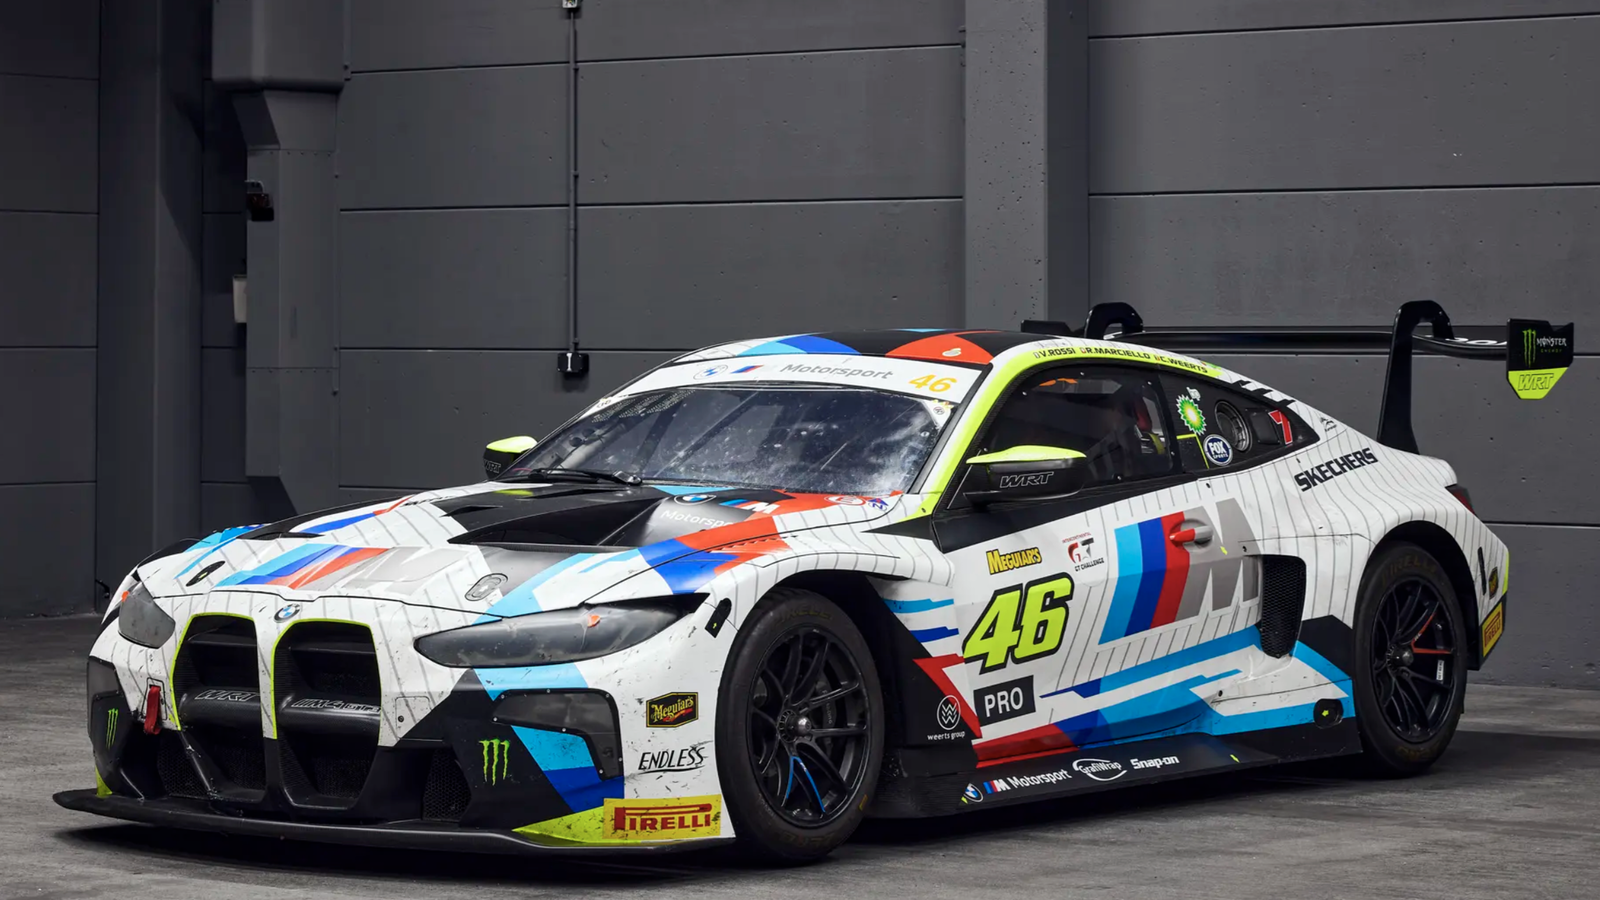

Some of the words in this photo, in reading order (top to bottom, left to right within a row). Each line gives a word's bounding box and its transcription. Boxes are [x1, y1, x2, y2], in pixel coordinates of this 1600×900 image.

[1536, 335, 1567, 347] MONSTER
[1040, 347, 1076, 358] V.ROSSI
[1086, 347, 1151, 359] R.MARCIELLO
[1160, 355, 1208, 374] C.WEERTS
[779, 364, 894, 380] Motorsport
[1517, 372, 1555, 392] WRT
[908, 373, 958, 393] 46
[1208, 440, 1227, 455] FOX
[999, 471, 1055, 489] WRT
[1293, 447, 1379, 493] SKECHERS
[985, 547, 1043, 576] MEGUIAR'S
[962, 572, 1075, 675] 46
[1484, 610, 1502, 649] PIRELLI
[194, 689, 258, 702] WRT
[984, 686, 1024, 718] PRO
[650, 695, 694, 723] Meguiar's
[927, 732, 951, 741] weerts
[950, 730, 966, 740] group
[637, 746, 706, 771] ENDLESS
[1078, 761, 1123, 775] GrafiWrap
[1130, 755, 1180, 770] Snap-on
[1010, 769, 1073, 790] Motorsport
[613, 803, 713, 832] PIRELLI
